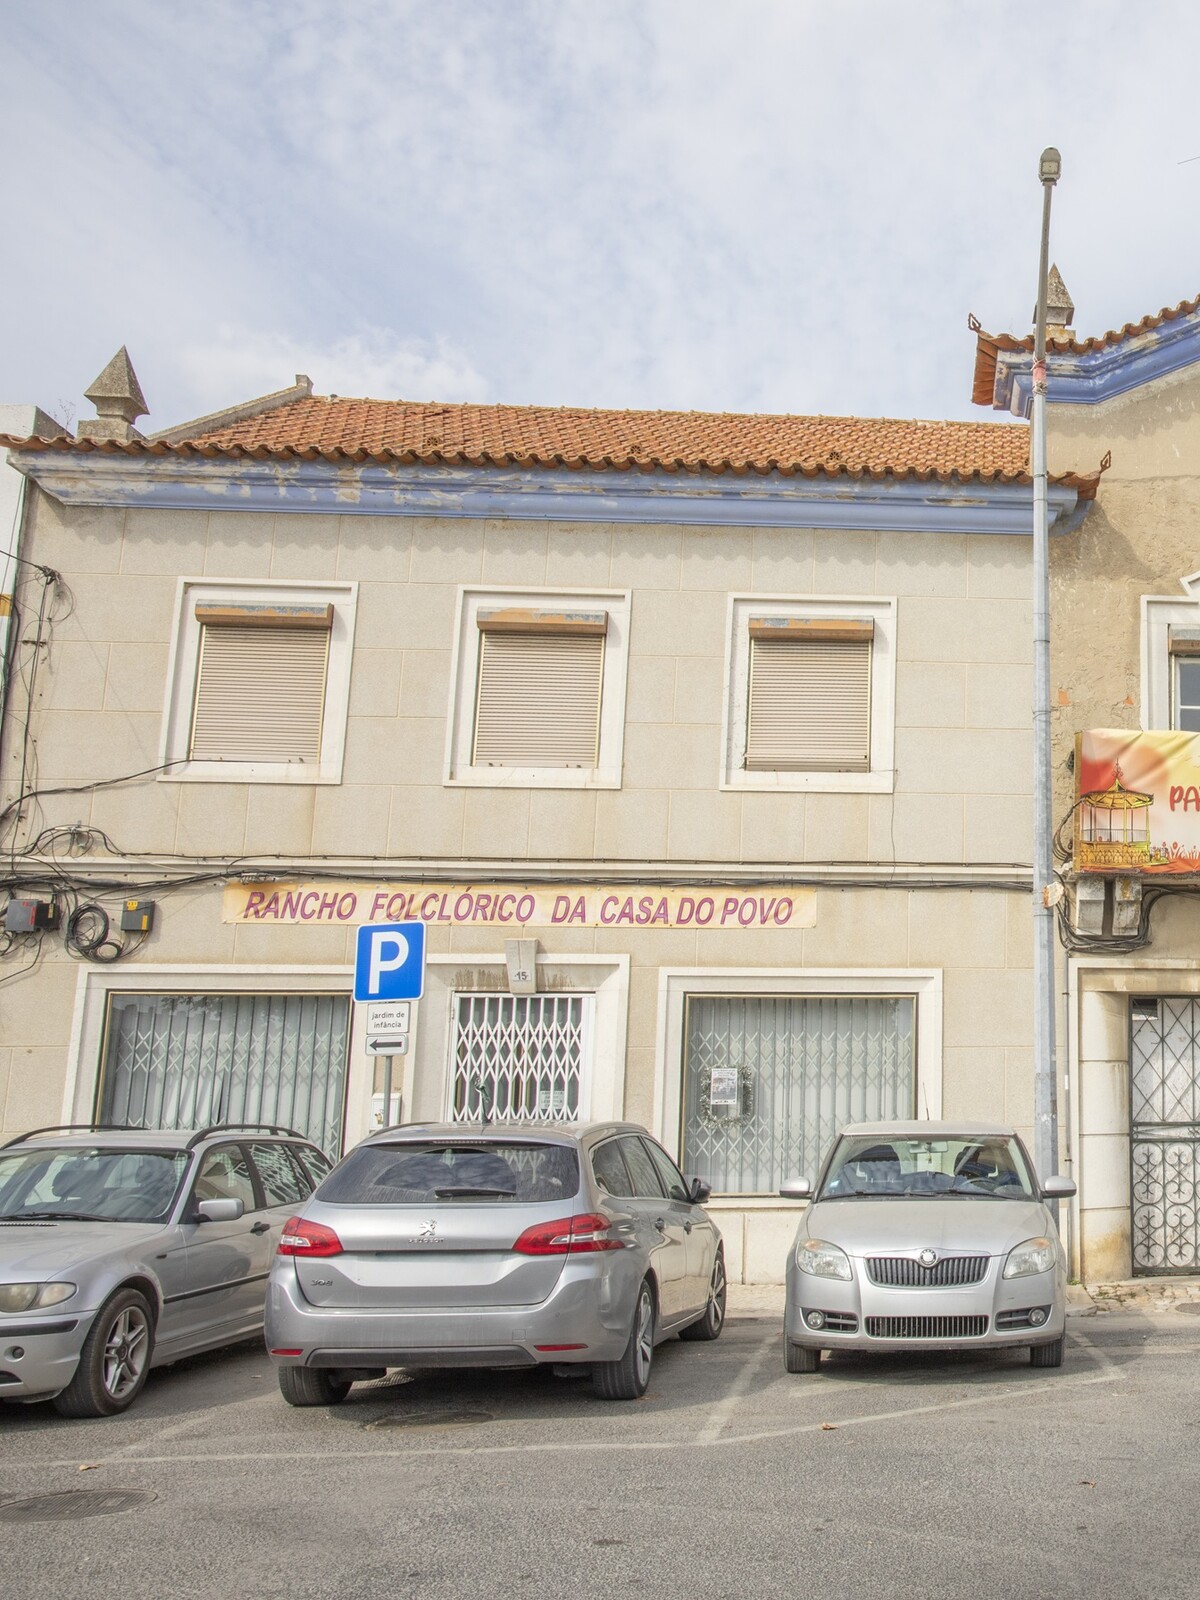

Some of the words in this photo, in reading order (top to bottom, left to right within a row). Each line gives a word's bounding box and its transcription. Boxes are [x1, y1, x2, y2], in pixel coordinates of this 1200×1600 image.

[243, 891, 357, 920] RANCHO
[369, 886, 535, 922] FOLCLÓRICO
[551, 895, 586, 923] DA
[600, 896, 668, 924] CASA
[676, 897, 715, 925] DO
[720, 897, 793, 925] POVO
[368, 930, 409, 994] P
[371, 1012, 394, 1020] jardim
